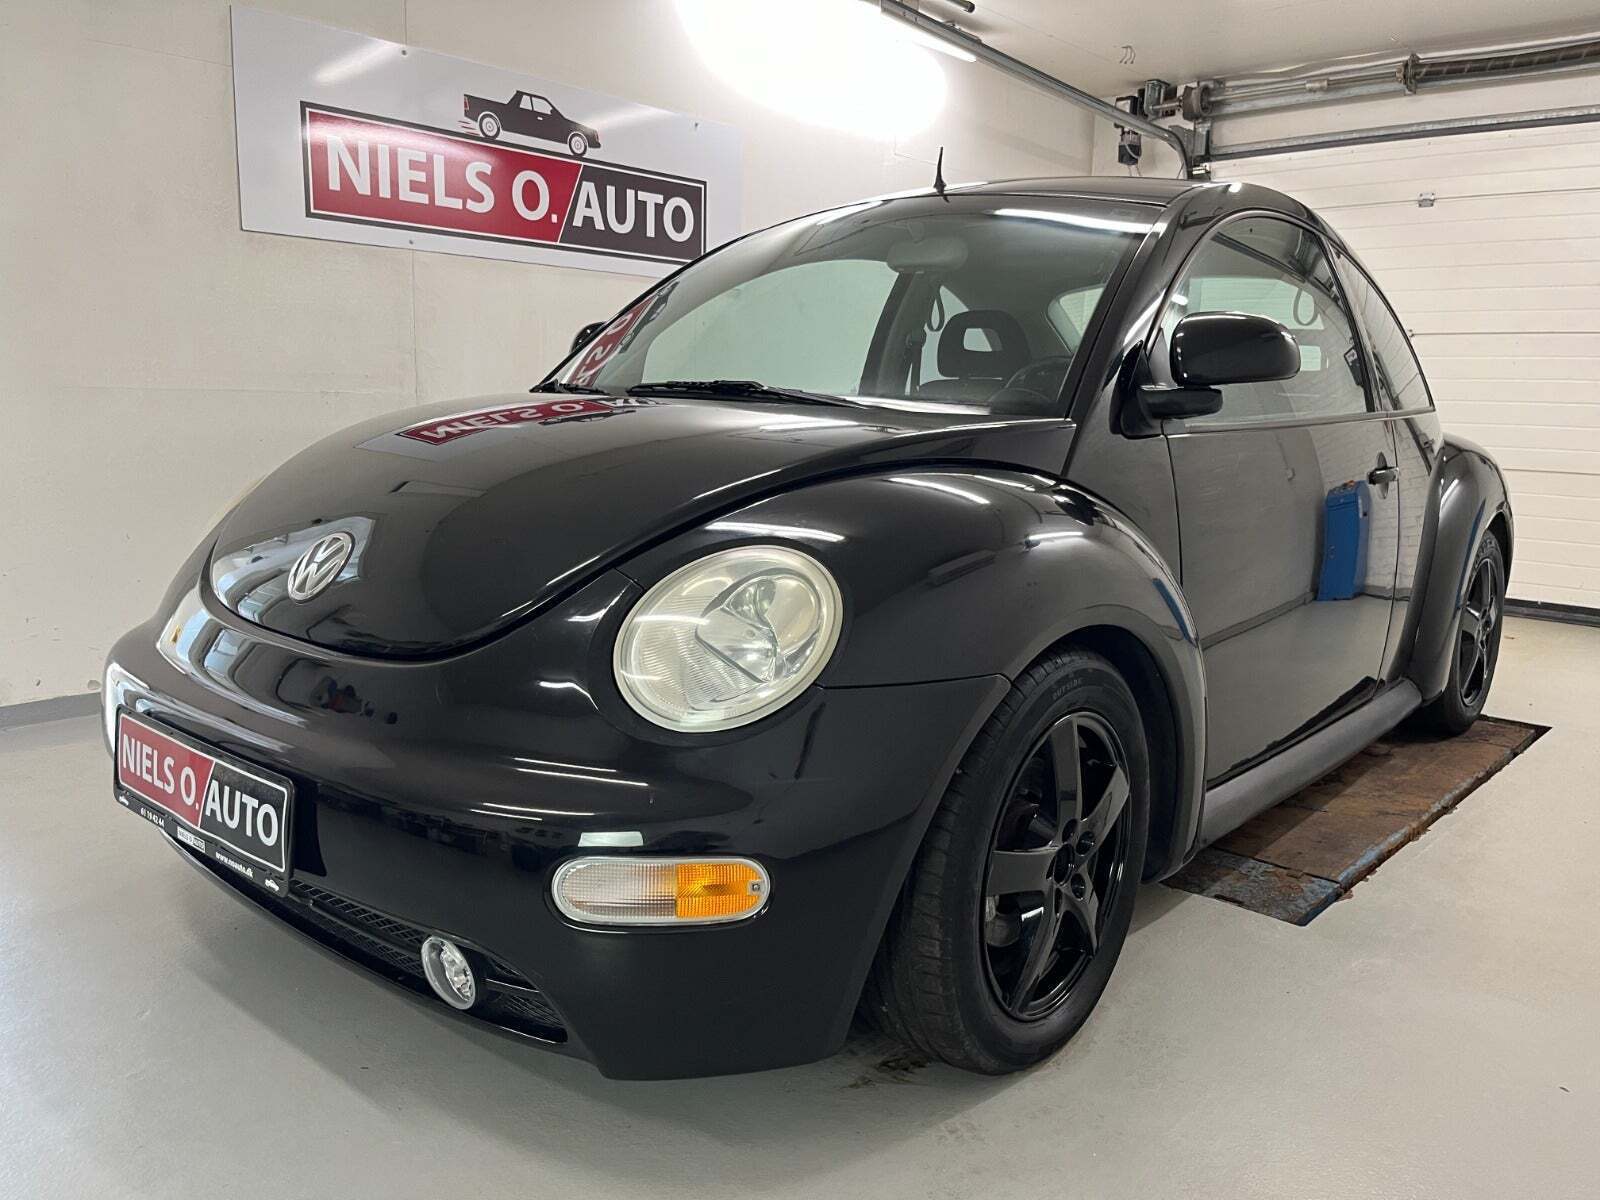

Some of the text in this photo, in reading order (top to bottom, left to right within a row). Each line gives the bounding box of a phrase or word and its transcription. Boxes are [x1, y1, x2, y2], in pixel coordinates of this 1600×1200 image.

[325, 134, 695, 243] NIELS O. AUTO
[288, 532, 352, 600] VW
[122, 734, 279, 847] NIELS O. AUTO
